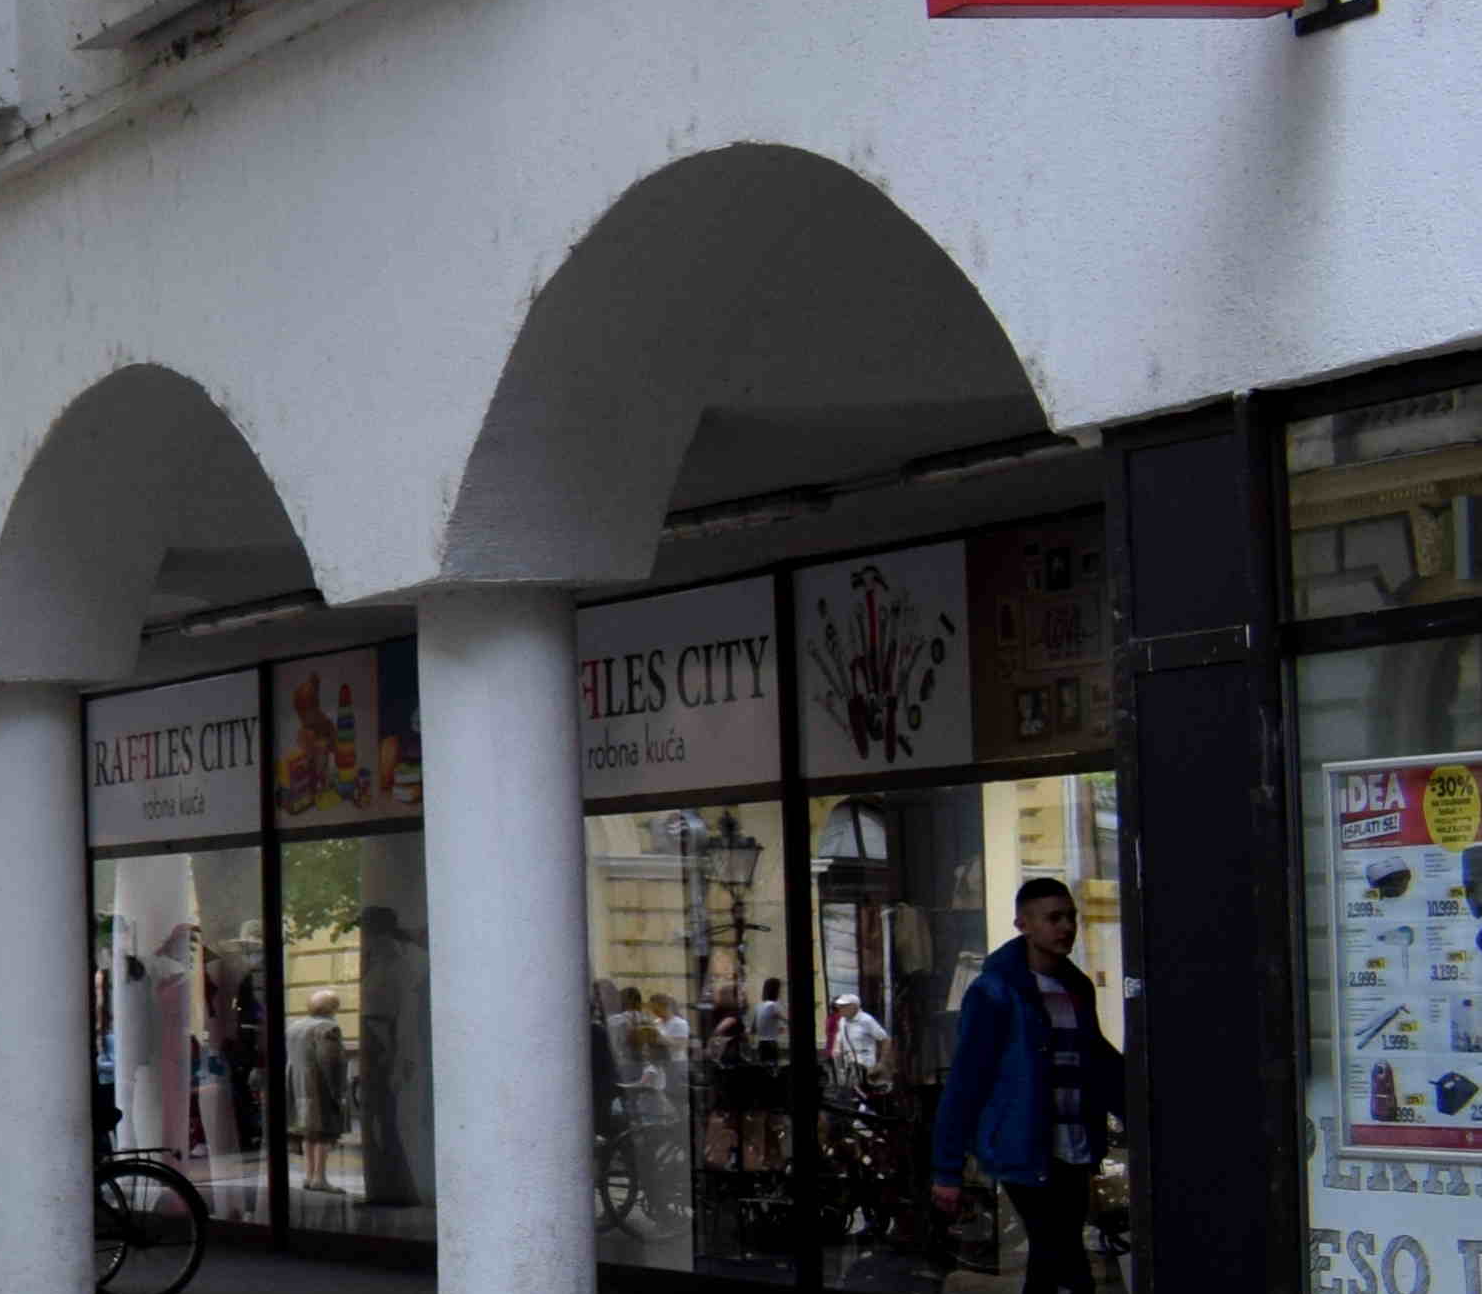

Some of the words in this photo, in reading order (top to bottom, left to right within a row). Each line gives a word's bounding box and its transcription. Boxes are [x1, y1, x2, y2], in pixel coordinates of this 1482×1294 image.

[676, 634, 770, 708] CITY
[94, 724, 194, 787] RAFFLES
[199, 716, 259, 772] CITY
[587, 726, 640, 770] robna
[644, 725, 685, 763] kuća
